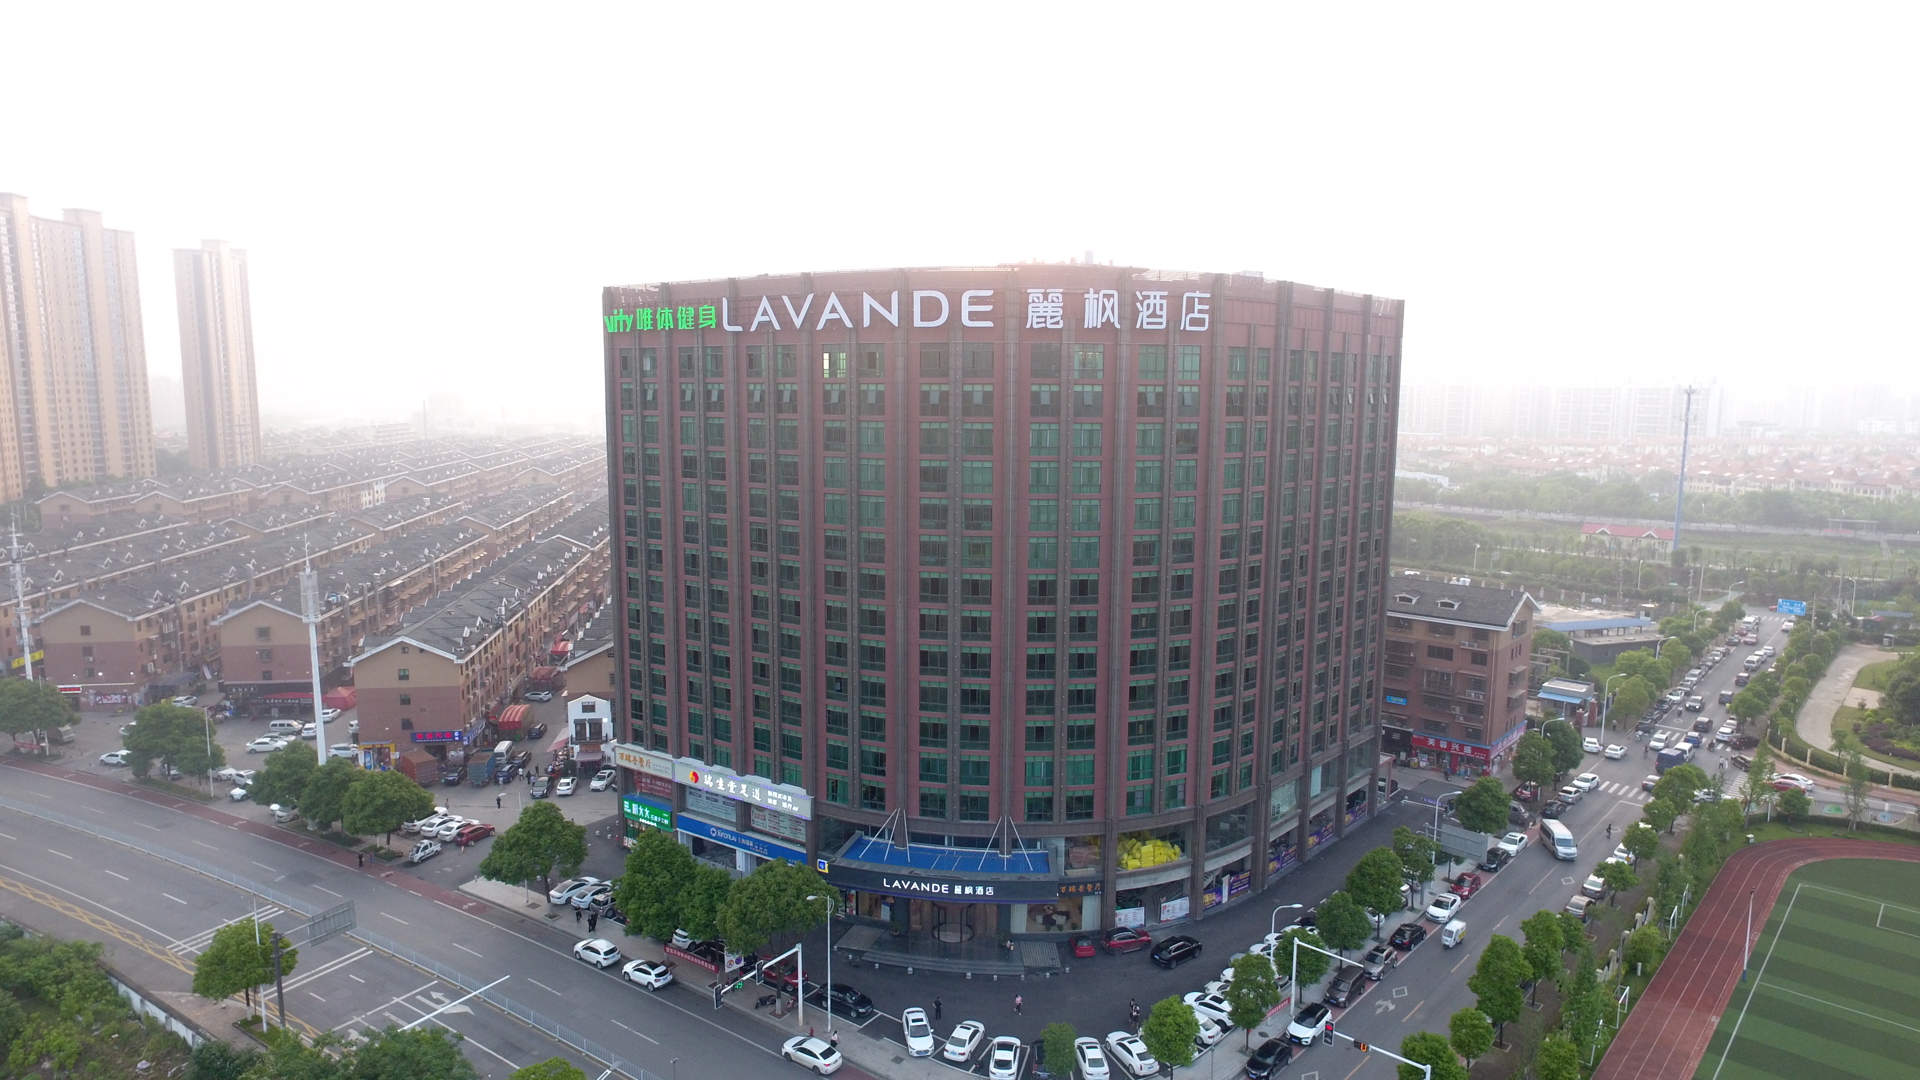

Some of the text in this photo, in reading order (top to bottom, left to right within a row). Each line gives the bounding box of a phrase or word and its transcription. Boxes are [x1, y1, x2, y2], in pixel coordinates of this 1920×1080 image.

[636, 304, 717, 331] 唯体健身
[722, 287, 1210, 332] LAVANDE 麗枫酒店
[703, 774, 762, 802] 瑞生堂足道
[883, 877, 994, 896] LAVANDE 麗枫酒店
